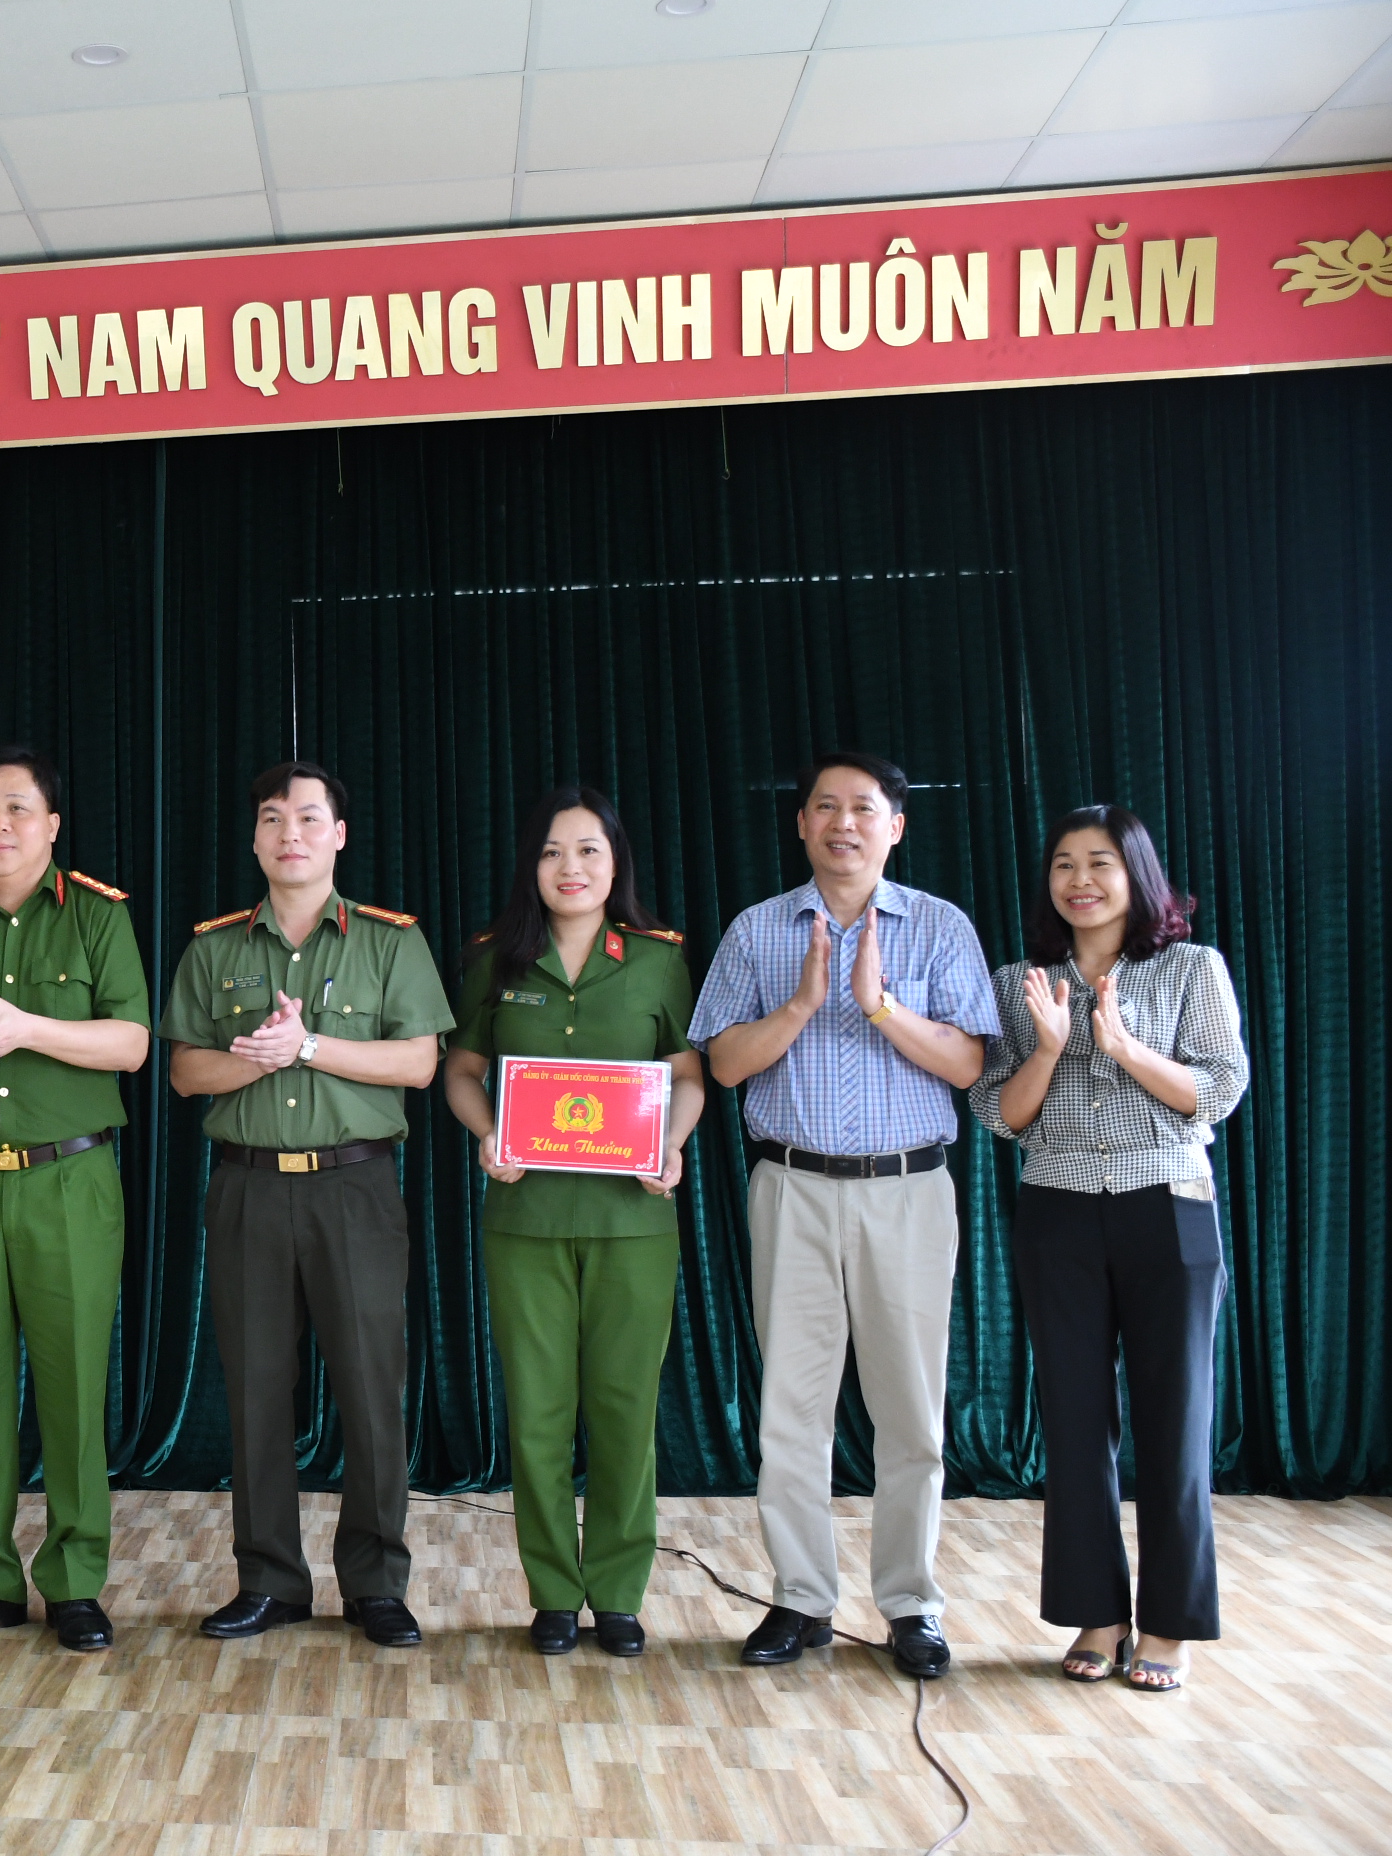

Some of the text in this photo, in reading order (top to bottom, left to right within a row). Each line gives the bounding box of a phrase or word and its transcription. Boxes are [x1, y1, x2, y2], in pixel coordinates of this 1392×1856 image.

[27, 306, 207, 401] NAM
[233, 288, 498, 397] QUANG
[522, 273, 713, 370] VINH
[742, 237, 990, 357] MUÔN
[1020, 222, 1218, 338] NĂM
[600, 1075, 609, 1083] AN
[527, 1136, 633, 1159] Khen Thưởng
